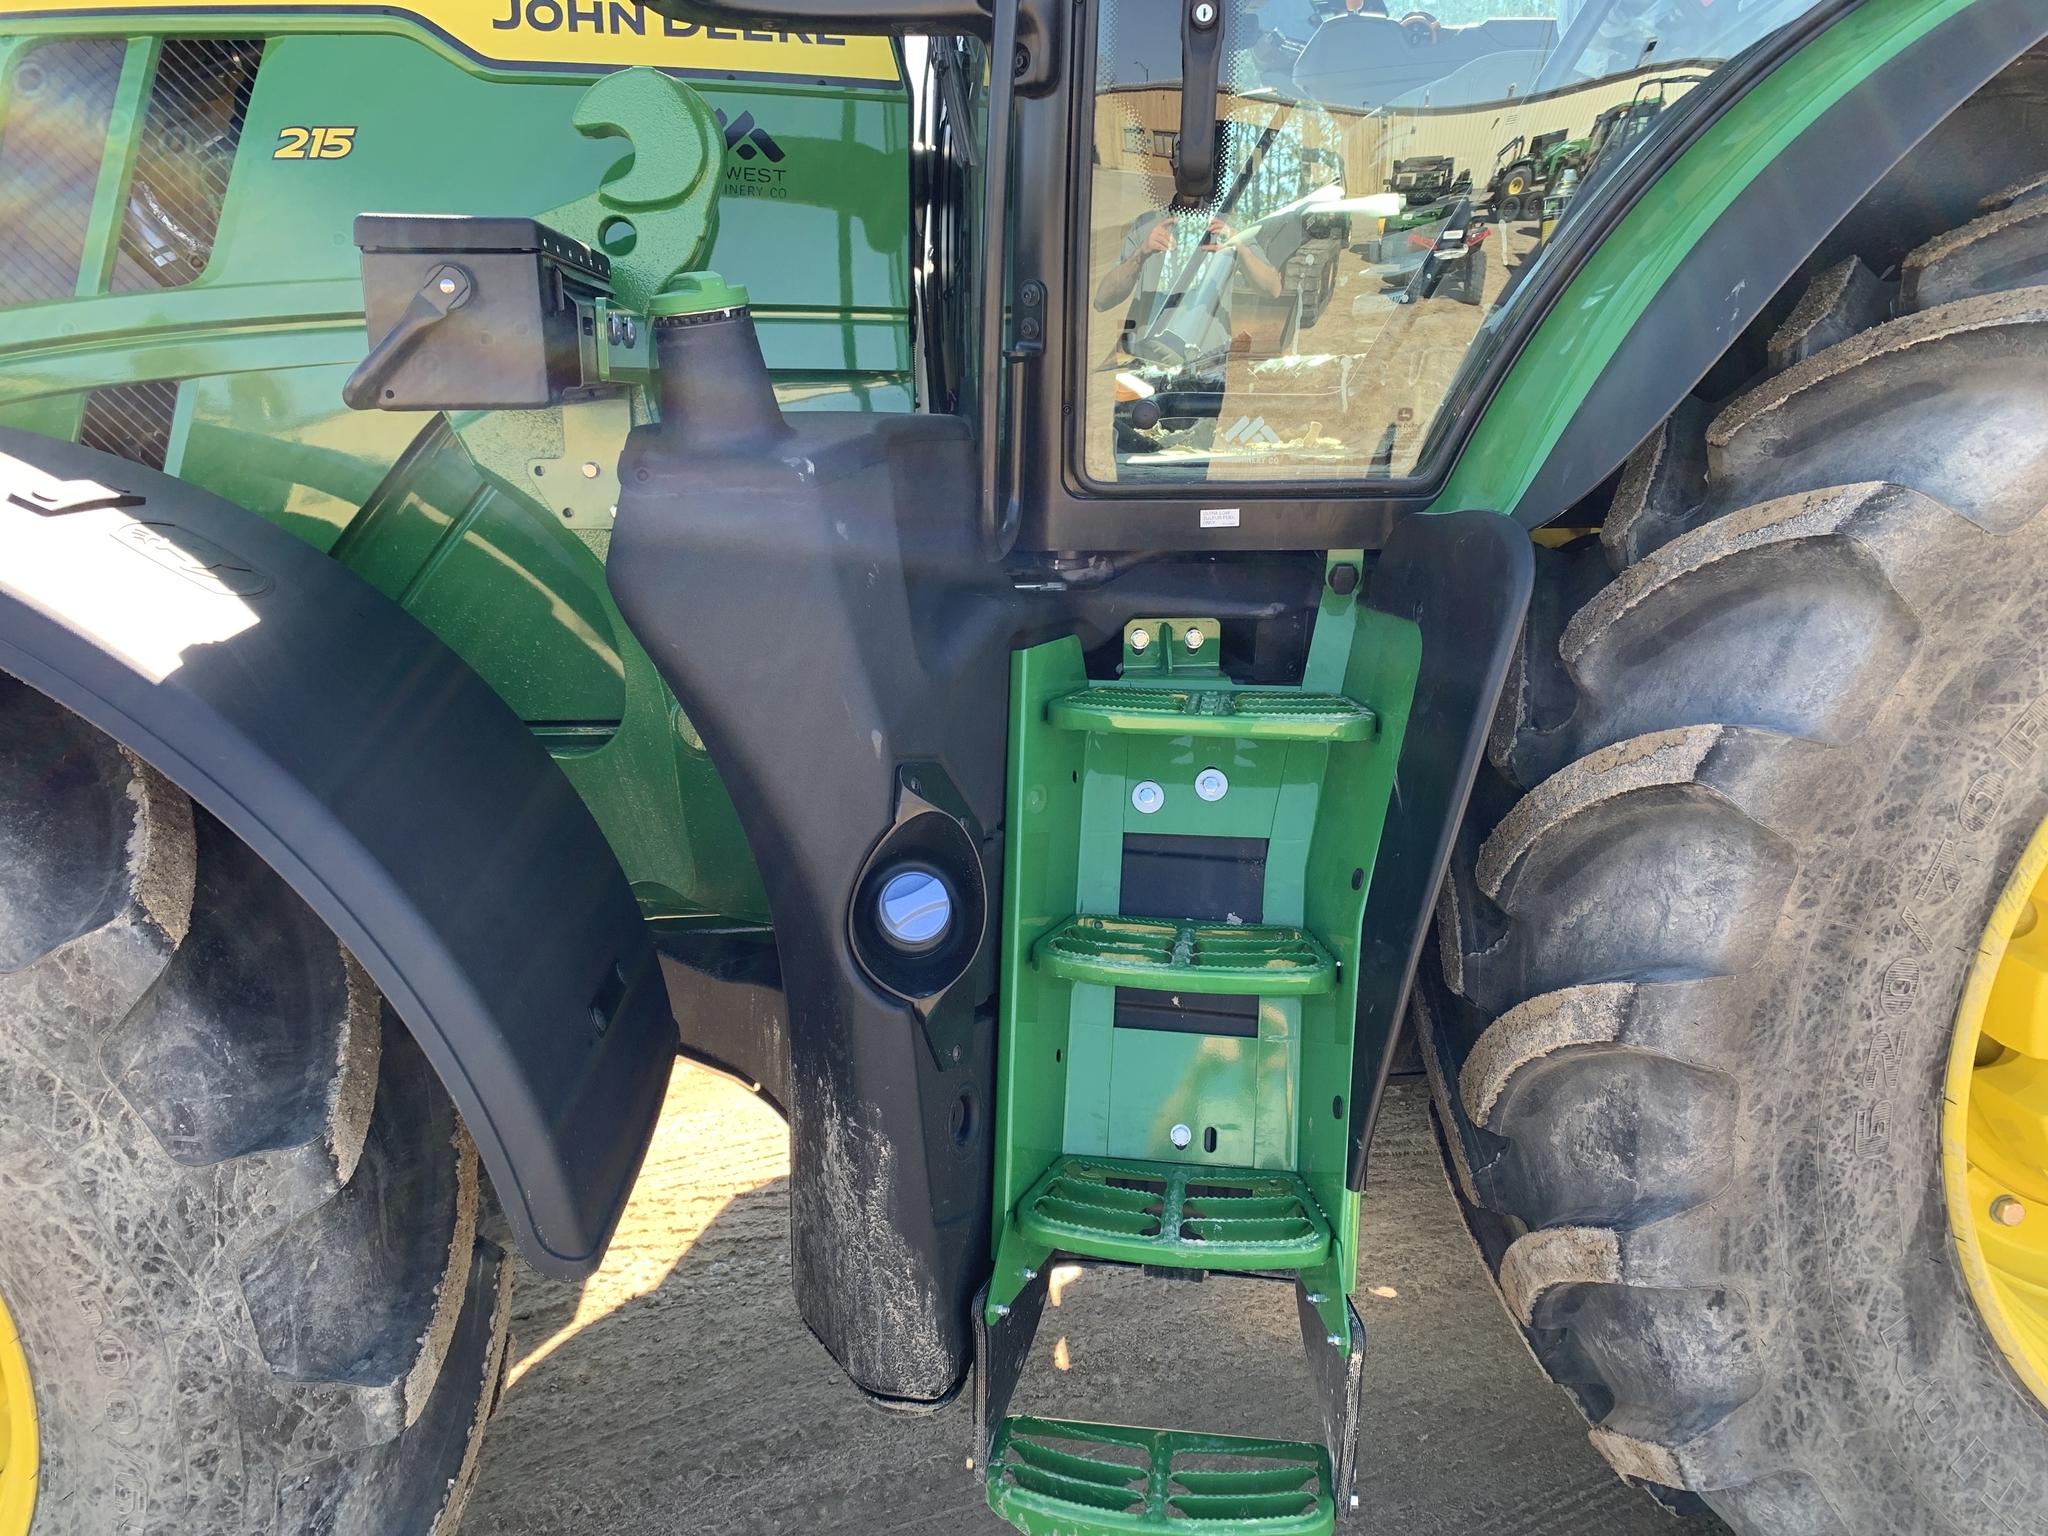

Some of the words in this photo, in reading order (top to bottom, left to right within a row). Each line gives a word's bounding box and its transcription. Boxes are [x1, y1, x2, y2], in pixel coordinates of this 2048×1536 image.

[492, 0, 646, 36] JOHN
[272, 126, 358, 161] 215
[721, 183, 764, 197] INERY
[769, 187, 787, 199] CO
[726, 166, 787, 184] WEST
[1881, 1313, 2048, 1536] TION
